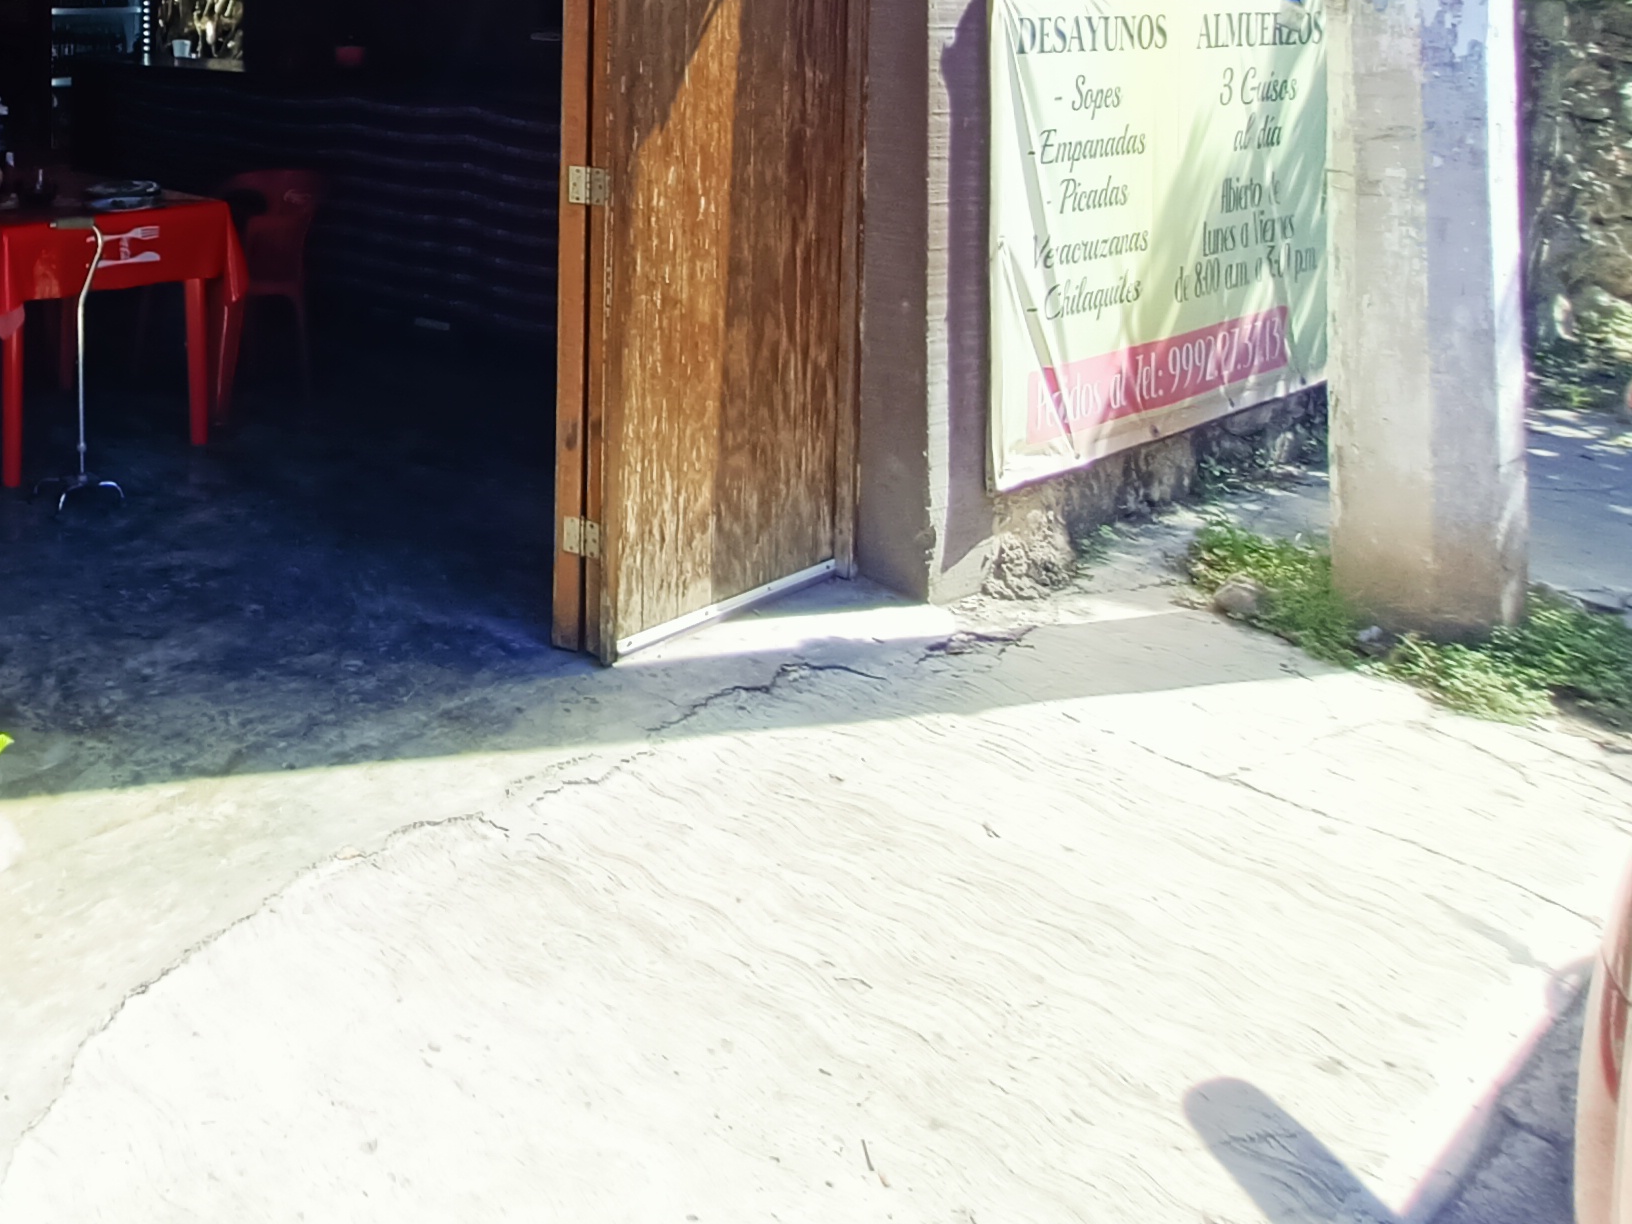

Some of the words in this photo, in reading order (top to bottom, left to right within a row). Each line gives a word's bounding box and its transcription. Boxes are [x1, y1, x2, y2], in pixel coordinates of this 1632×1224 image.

[1016, 14, 1168, 55] DESAYUNOS
[1071, 74, 1122, 121] Sopes
[1219, 67, 1235, 106] 3
[1240, 66, 1298, 105] Guisos
[1039, 123, 1146, 173] Empanadas
[1234, 112, 1256, 152] al
[1059, 175, 1129, 214] Picadas
[1220, 177, 1263, 214] Abierto
[1033, 230, 1149, 269] Veacruzanas
[1202, 221, 1236, 257] Lunes
[1240, 222, 1249, 248] a
[1044, 269, 1143, 321] Chilaquiles
[1174, 266, 1189, 303] de
[1036, 373, 1104, 431] Pedos
[1110, 360, 1127, 410] al
